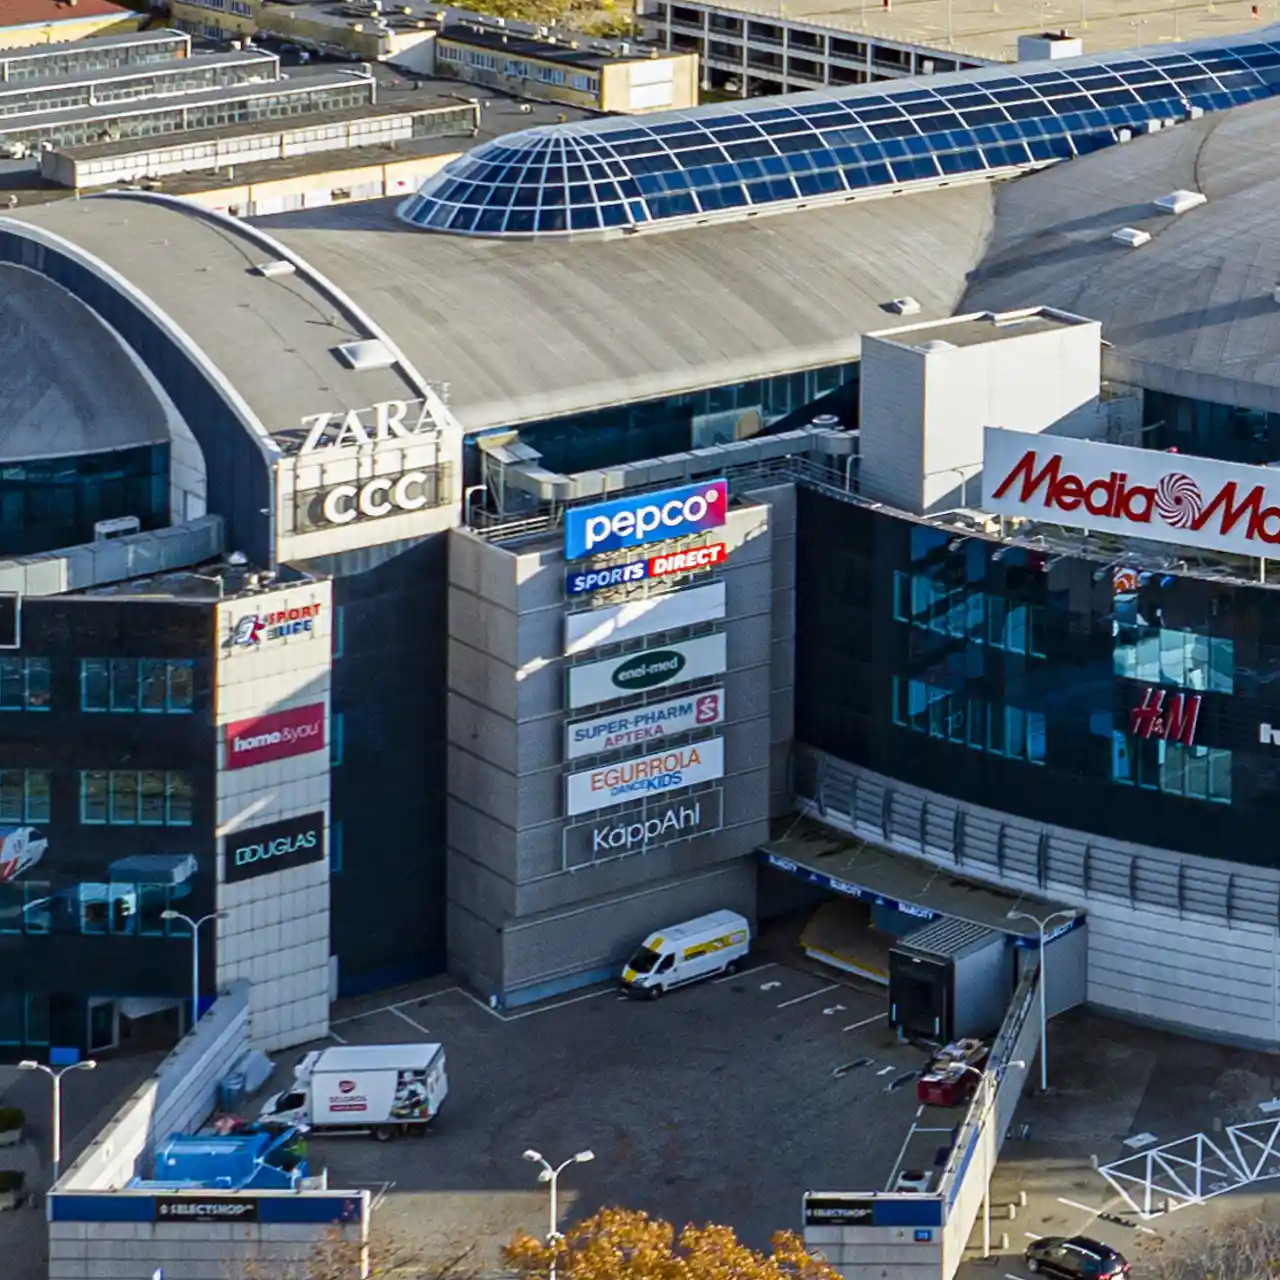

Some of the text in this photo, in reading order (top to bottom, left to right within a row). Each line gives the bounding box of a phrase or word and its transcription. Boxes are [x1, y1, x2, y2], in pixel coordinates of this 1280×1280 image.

[301, 396, 450, 455] ZARA
[324, 472, 428, 524] CCC
[992, 451, 1156, 524] Media
[585, 494, 709, 550] pepco
[574, 546, 722, 592] SPORTS DIRECT
[267, 603, 322, 625] SPORT
[573, 702, 694, 743] SUPER-PHARM
[604, 725, 665, 749] APTEKA
[1131, 687, 1202, 746] H&M
[590, 748, 702, 792] EGURROLA
[235, 830, 317, 866] DOUGLAS
